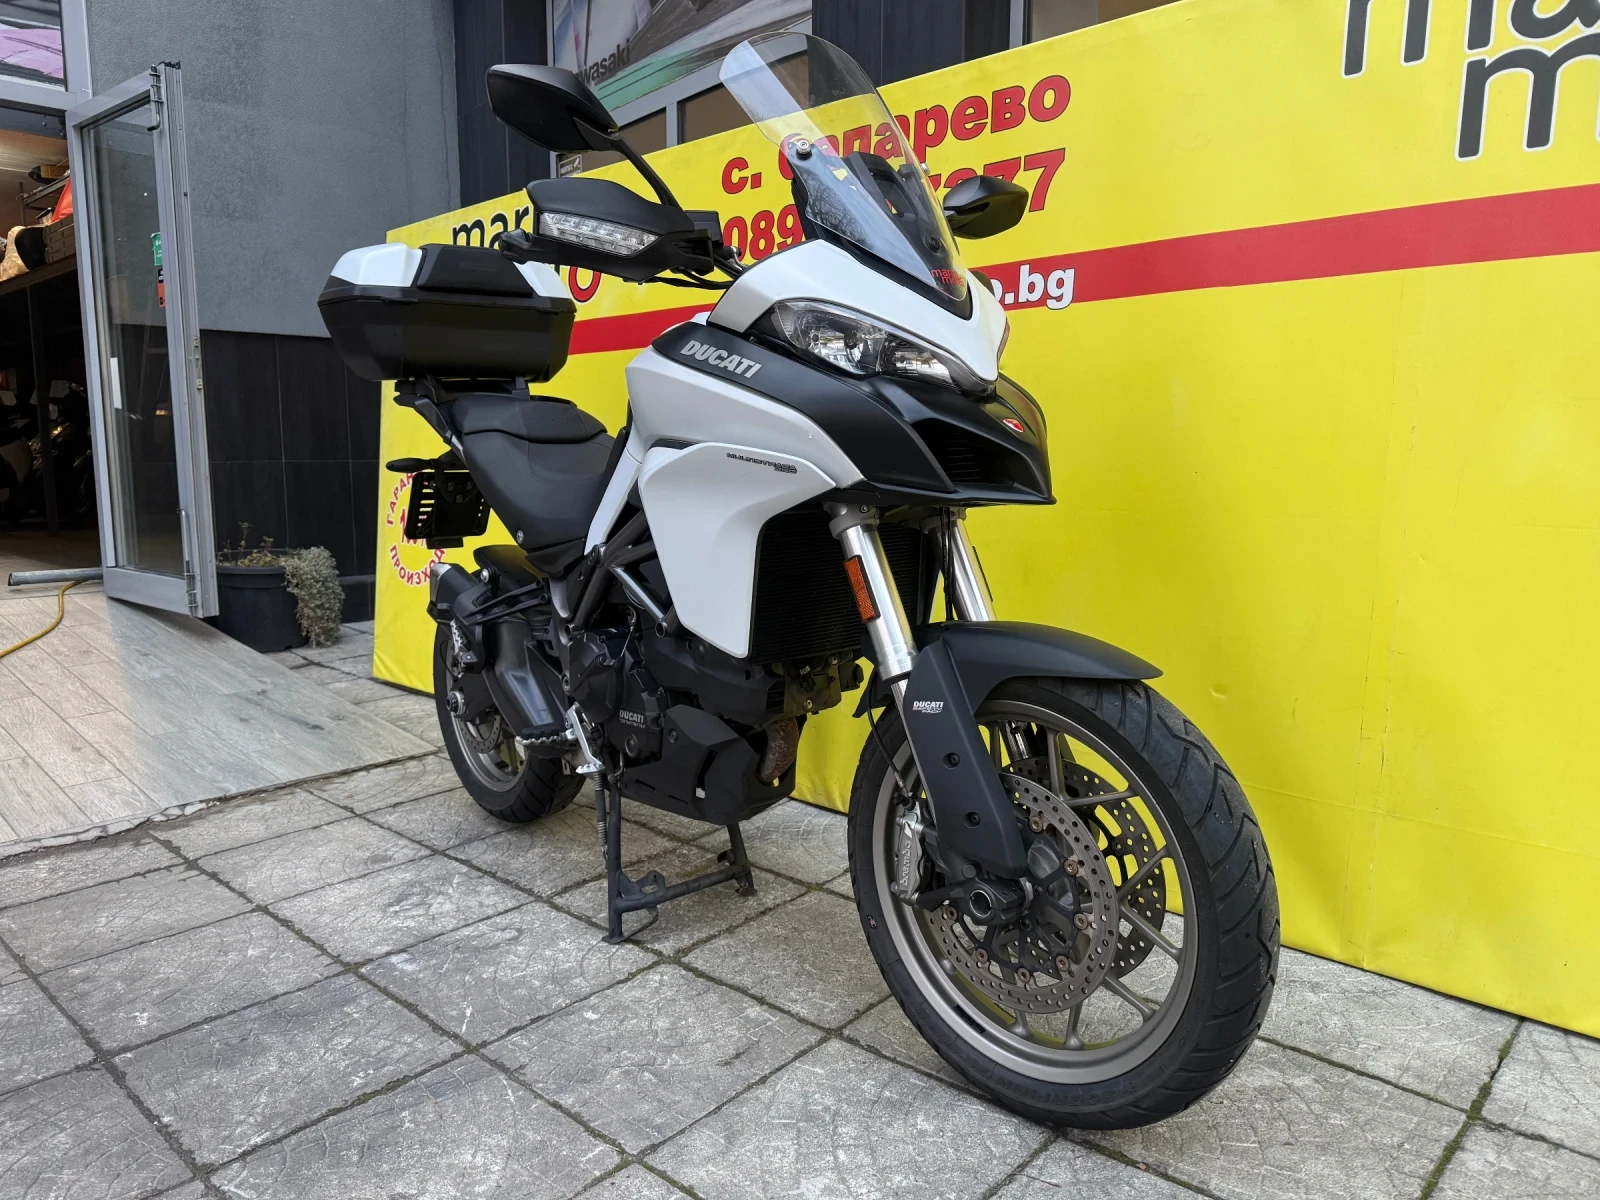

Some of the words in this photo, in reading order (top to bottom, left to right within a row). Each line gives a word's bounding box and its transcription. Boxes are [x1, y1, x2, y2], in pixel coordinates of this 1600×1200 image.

[578, 38, 630, 84] wasaki
[680, 340, 763, 379] DUCATI
[619, 709, 644, 724] DUCATI
[913, 700, 944, 708] DUCATI
[900, 840, 912, 887] brembo
